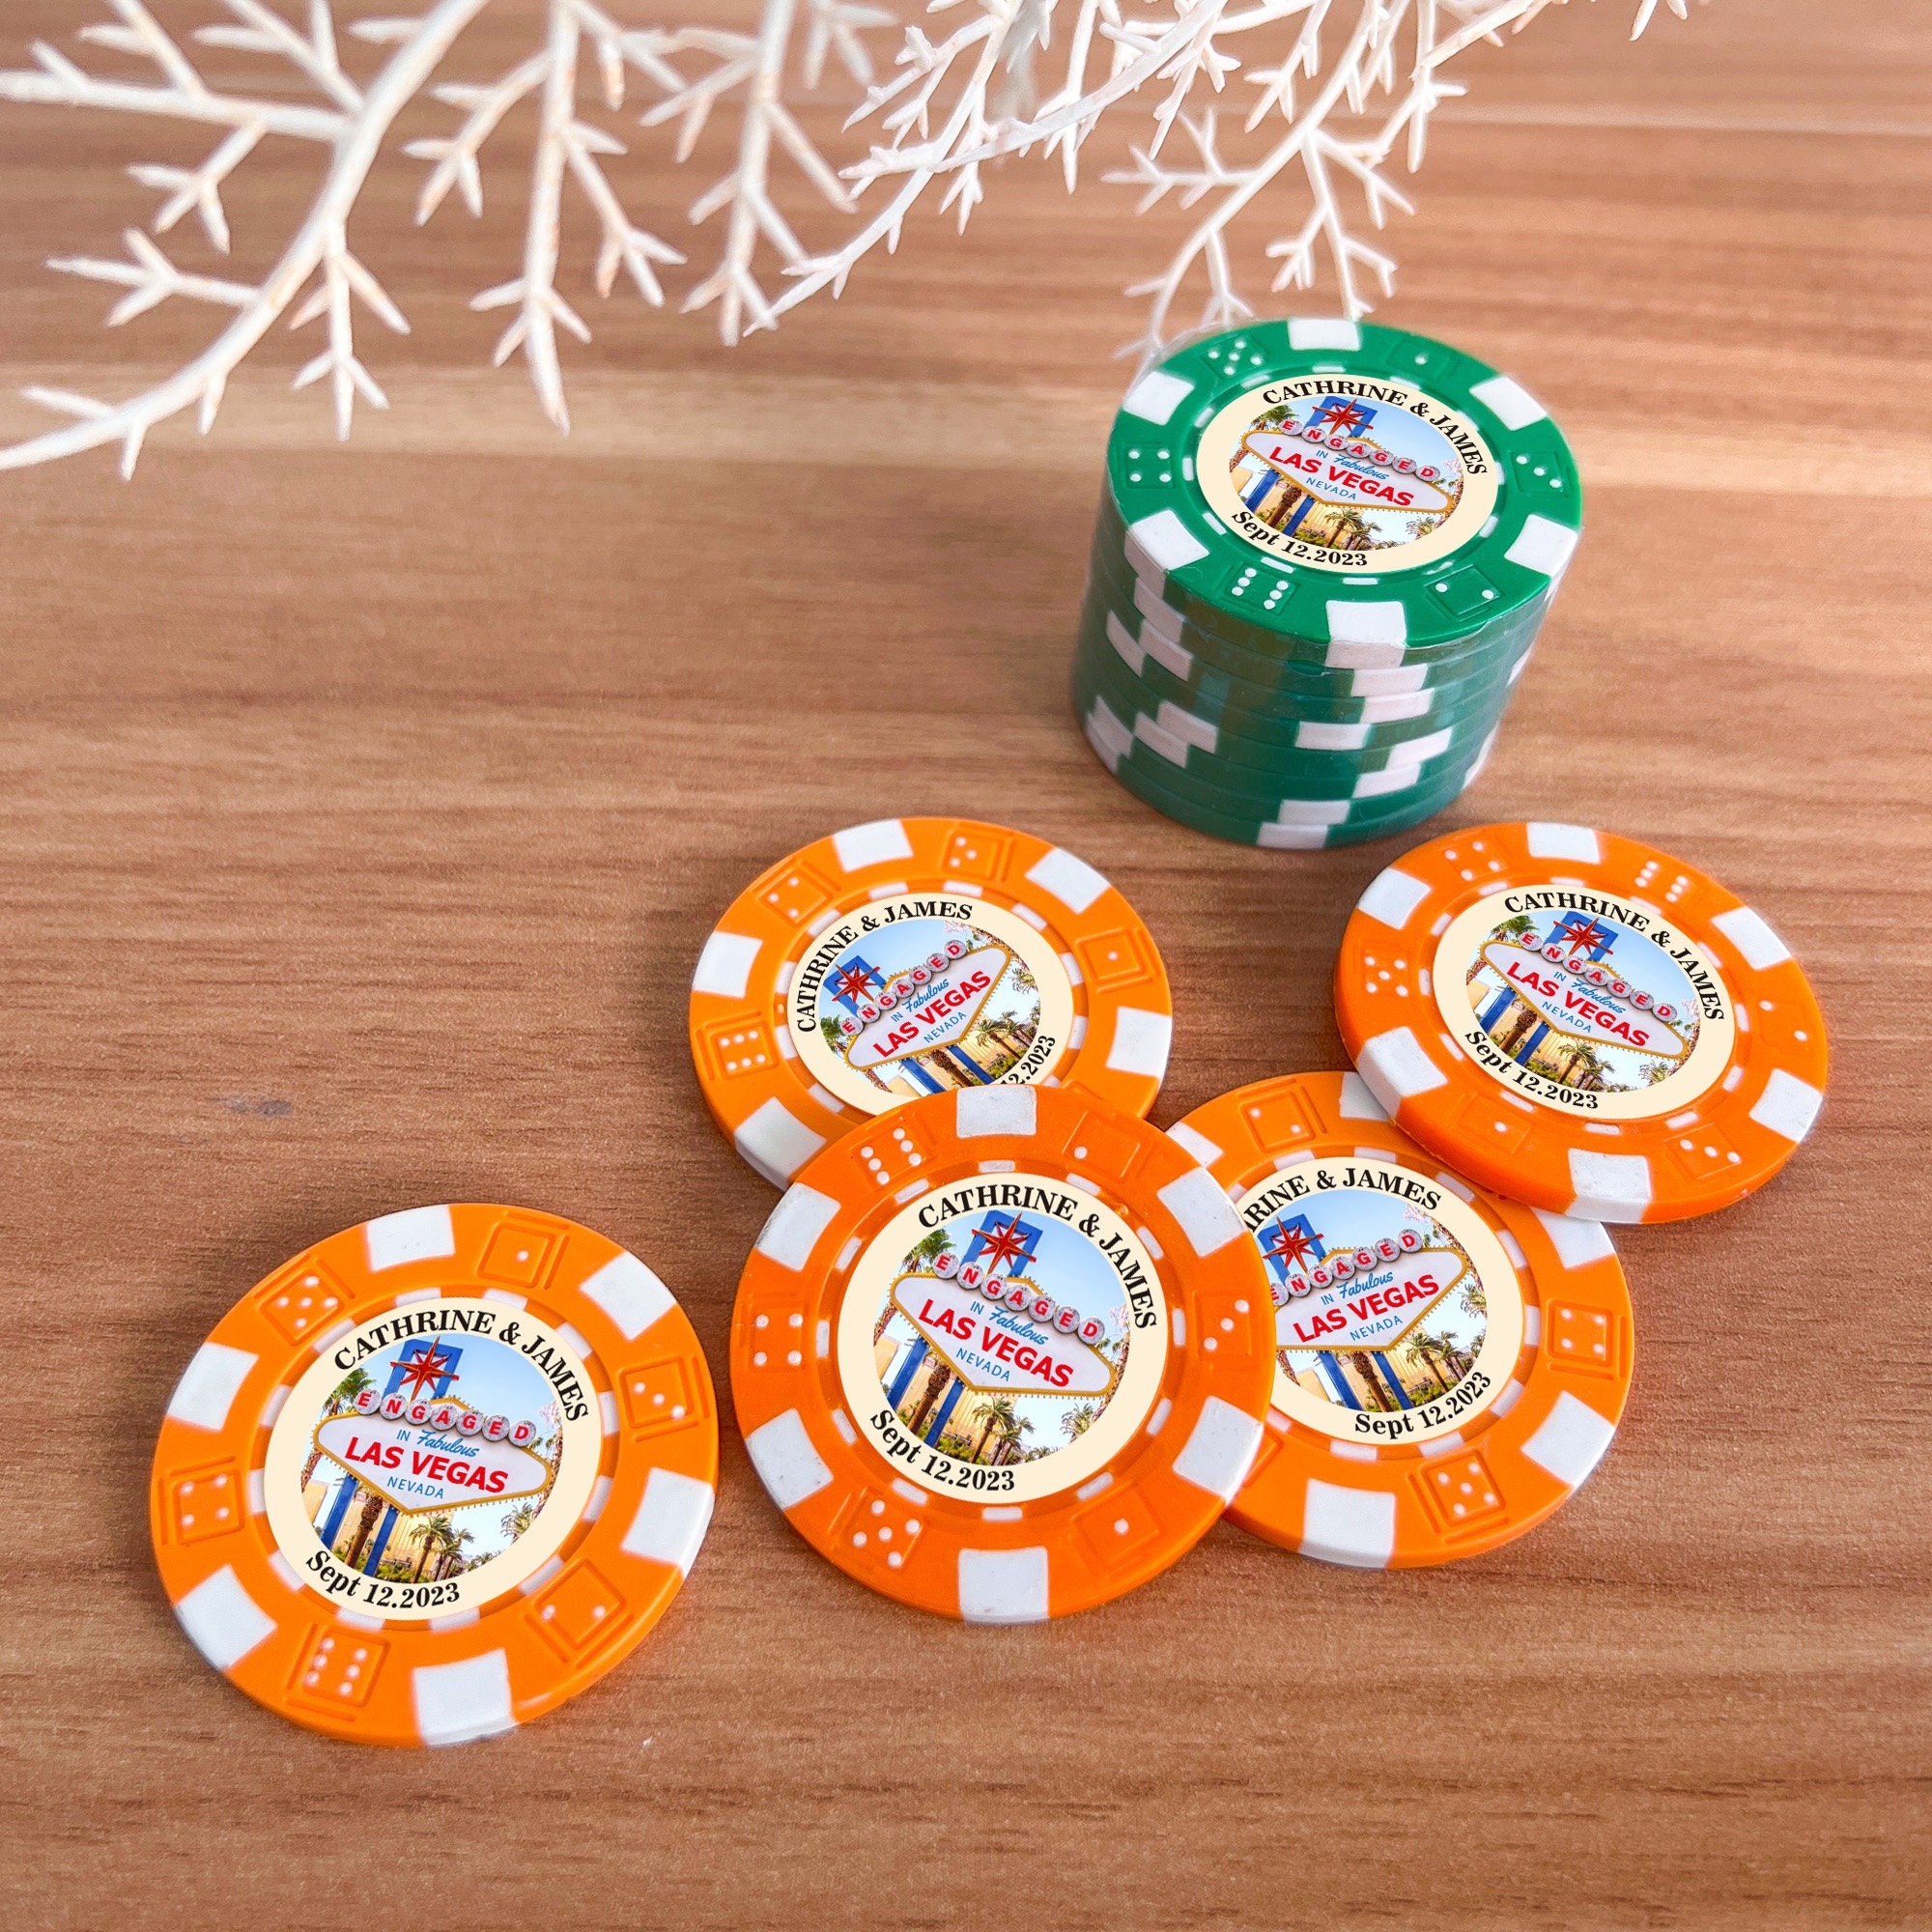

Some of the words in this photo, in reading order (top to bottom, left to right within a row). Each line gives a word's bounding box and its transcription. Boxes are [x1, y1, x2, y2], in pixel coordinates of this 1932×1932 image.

[1264, 381, 1407, 407] CATHRINE
[1410, 402, 1429, 417] &
[1430, 414, 1488, 475] JAMES
[1282, 420, 1435, 477] ENGAGED
[1268, 446, 1323, 473] LAS
[1327, 466, 1414, 506] VEGAS
[1306, 477, 1356, 500] NEVADA
[1316, 450, 1329, 459] IN
[1333, 453, 1389, 480] Fabulous
[1232, 511, 1280, 546] Sept
[1280, 541, 1368, 566] 12.2023
[797, 925, 859, 1033] CATHRINE
[860, 915, 880, 931] &
[884, 901, 973, 923] JAMES
[1504, 893, 1650, 932] CATHRINE
[1651, 930, 1670, 948] &
[1670, 947, 1724, 1021] JAMES
[1522, 934, 1670, 1017] ENGAGED
[843, 944, 960, 1033] ENGAGED
[872, 1022, 920, 1057] LAS
[915, 970, 991, 1025] VEGAS
[891, 1012, 905, 1023] IN
[901, 979, 949, 1012] Fabulous
[1506, 962, 1560, 997] LAS
[1563, 989, 1650, 1047] VEGAS
[1542, 1001, 1592, 1033] NEVADA
[1553, 971, 1568, 981] IN
[1570, 978, 1627, 1013] Fabulous
[923, 1011, 967, 1044] NEVADA
[1001, 1036, 1056, 1084] 2.2023
[1464, 1031, 1514, 1073] Sept
[1512, 1071, 1599, 1109] 12.2023
[1316, 1170, 1337, 1189] &
[1343, 1168, 1442, 1210] JAMES
[918, 1184, 1078, 1228] CATHRINE
[1079, 1213, 1100, 1237] &
[1098, 1233, 1156, 1329] JAMES
[936, 1256, 1098, 1337] ENGAGED
[1293, 1308, 1348, 1343] LAS
[1347, 1274, 1439, 1320] VEGAS
[1321, 1293, 1336, 1306] IN
[1336, 1271, 1393, 1298] Fabulous
[918, 1298, 978, 1340] LAS
[981, 1326, 1074, 1387] VEGAS
[970, 1300, 984, 1315] IN
[989, 1306, 1048, 1345] Fabulous
[1350, 1315, 1403, 1341] NEVADA
[334, 1310, 496, 1370] CATHRINE
[498, 1321, 521, 1345] &
[522, 1335, 589, 1422] JAMES
[956, 1348, 1010, 1381] NEVADA
[357, 1392, 529, 1439] ENGAGED
[1354, 1413, 1414, 1439] Sept
[1416, 1371, 1492, 1428] 12.2023
[345, 1436, 404, 1469] LAS
[412, 1451, 508, 1493] VEGAS
[397, 1429, 411, 1442] IN
[416, 1429, 480, 1458] Fabulous
[869, 1409, 921, 1463] Sept
[921, 1455, 1014, 1491] 12.2023
[386, 1476, 444, 1499] NEVADA
[305, 1550, 363, 1596] Sept
[362, 1582, 460, 1608] 12.2023
